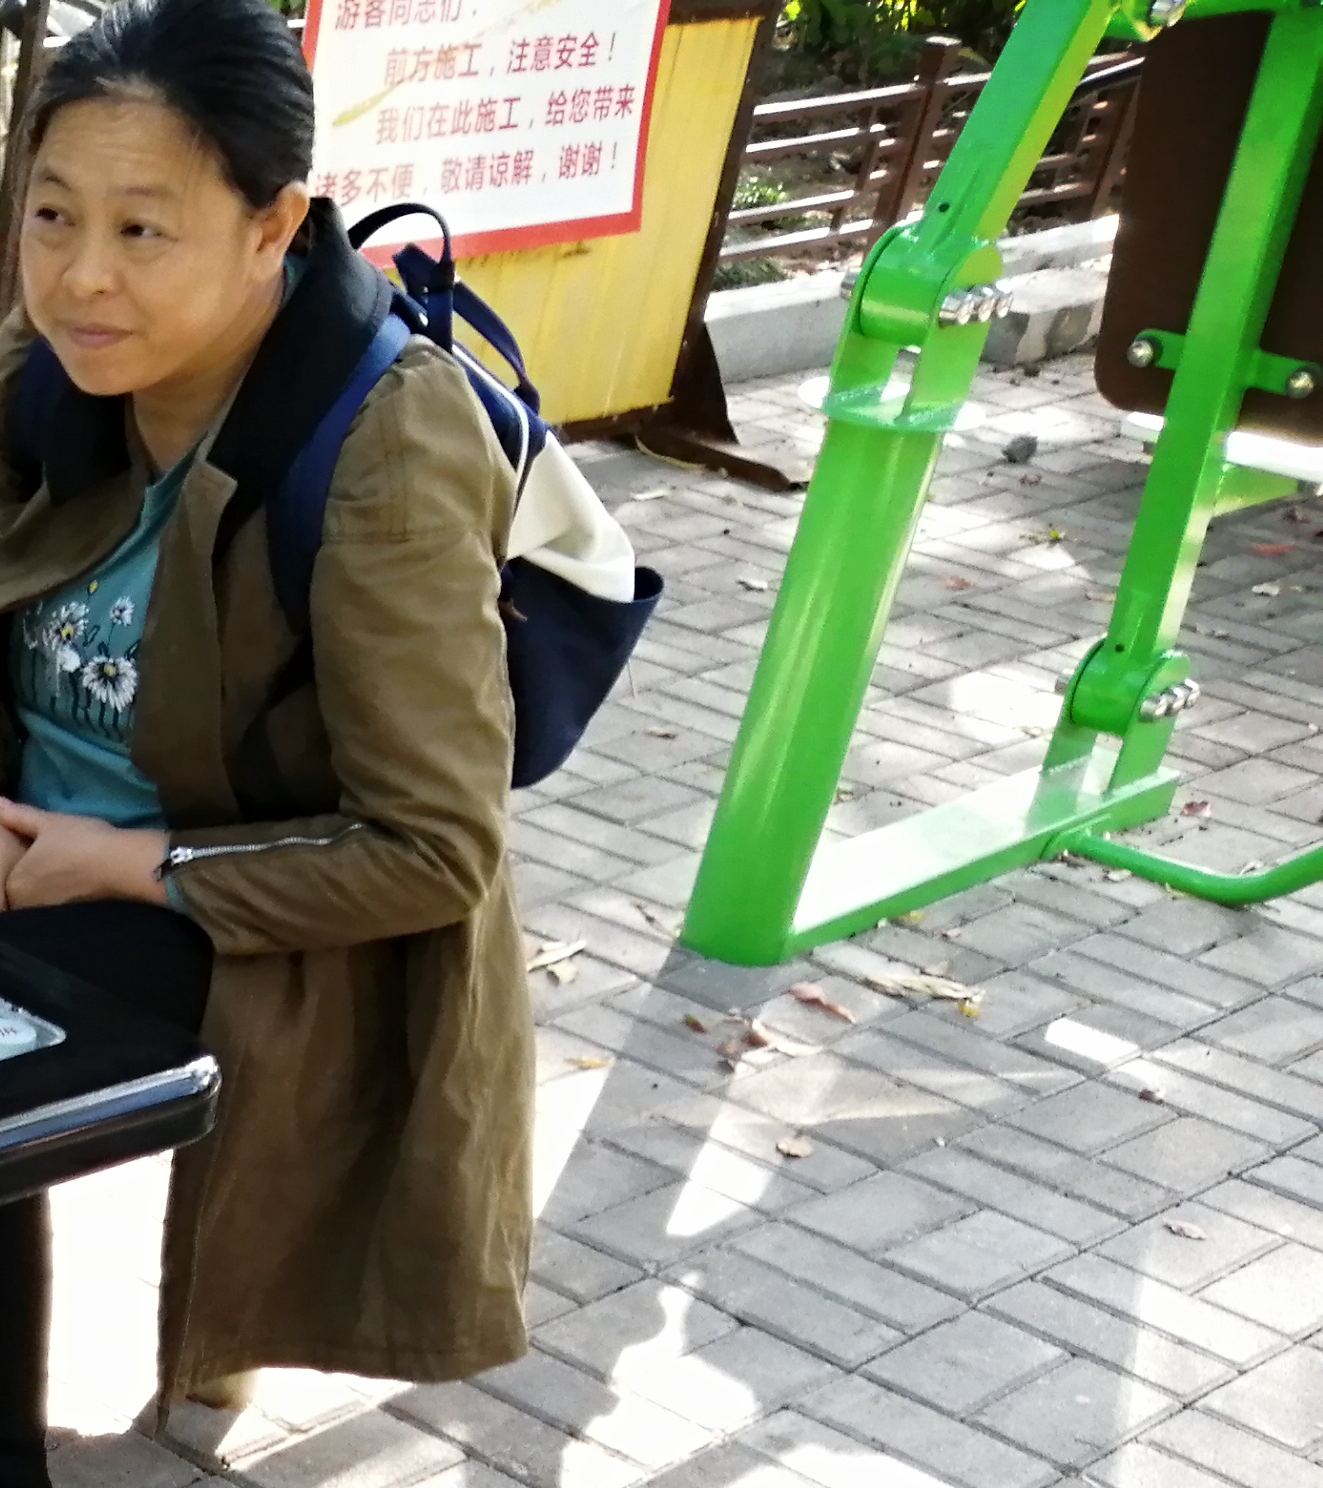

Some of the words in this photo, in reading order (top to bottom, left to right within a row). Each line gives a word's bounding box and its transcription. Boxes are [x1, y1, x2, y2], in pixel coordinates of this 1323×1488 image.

[384, 33, 617, 86] 前方施工，注意安全！
[375, 84, 635, 145] 我们在此施工，给您带来
